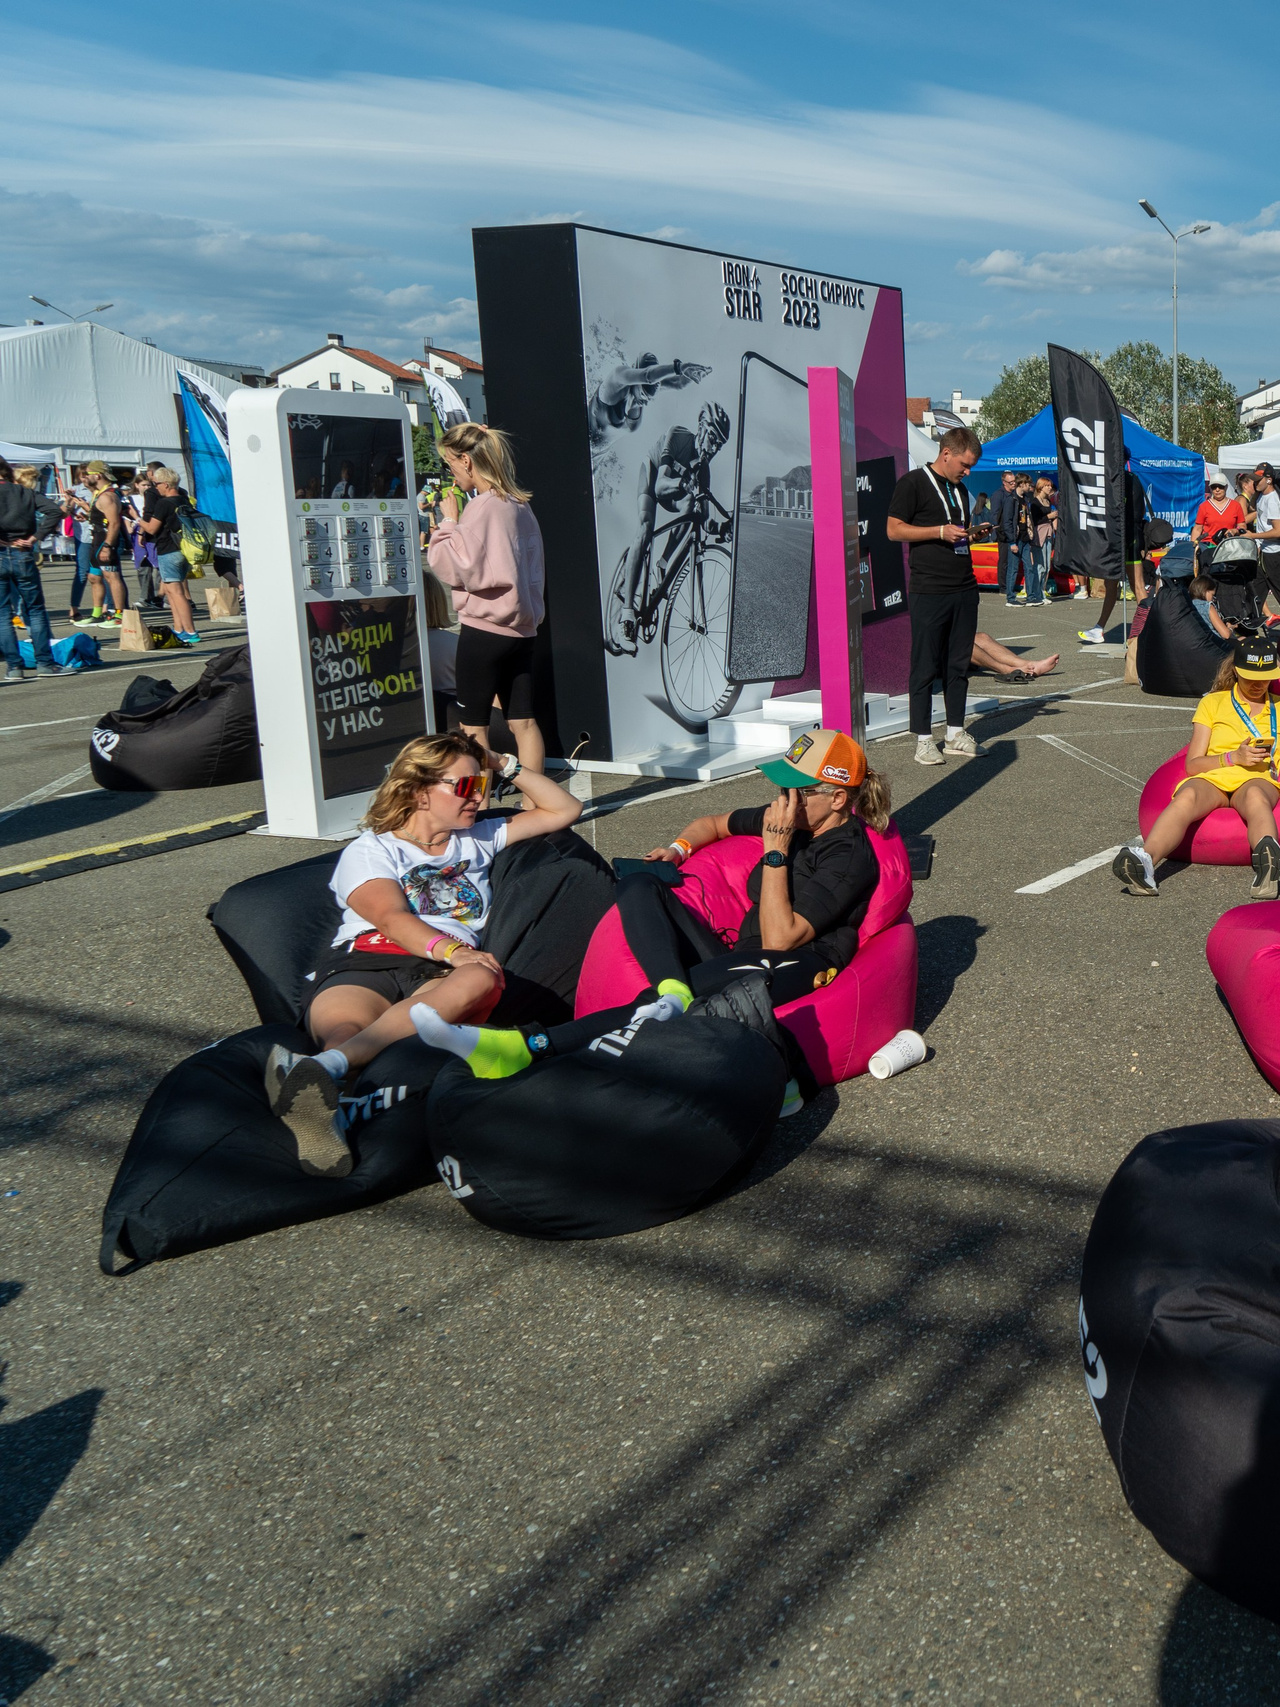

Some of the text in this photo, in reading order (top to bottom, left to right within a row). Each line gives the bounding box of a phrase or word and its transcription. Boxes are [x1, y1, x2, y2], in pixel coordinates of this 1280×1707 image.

[721, 261, 749, 287] IRON
[780, 272, 865, 310] SOCHI СИРИУС
[724, 287, 763, 321] STAR
[781, 297, 821, 330] 2023
[1062, 417, 1106, 530] TELE2
[324, 522, 329, 533] 1
[361, 522, 368, 533] 2
[398, 521, 405, 532] 3
[215, 532, 239, 550] ELE
[399, 544, 406, 555] 6
[325, 547, 333, 558] 4
[363, 545, 370, 556] 5
[327, 571, 334, 582] 7
[365, 569, 372, 580] 8
[401, 568, 407, 578] 9
[884, 590, 902, 607] TELE2
[310, 622, 393, 659] ЗАРЯДИ
[315, 649, 371, 686] СВОЙ
[318, 671, 417, 713] ТЕЛЕФОН
[323, 706, 384, 741] У НАС
[766, 823, 791, 835] 4467
